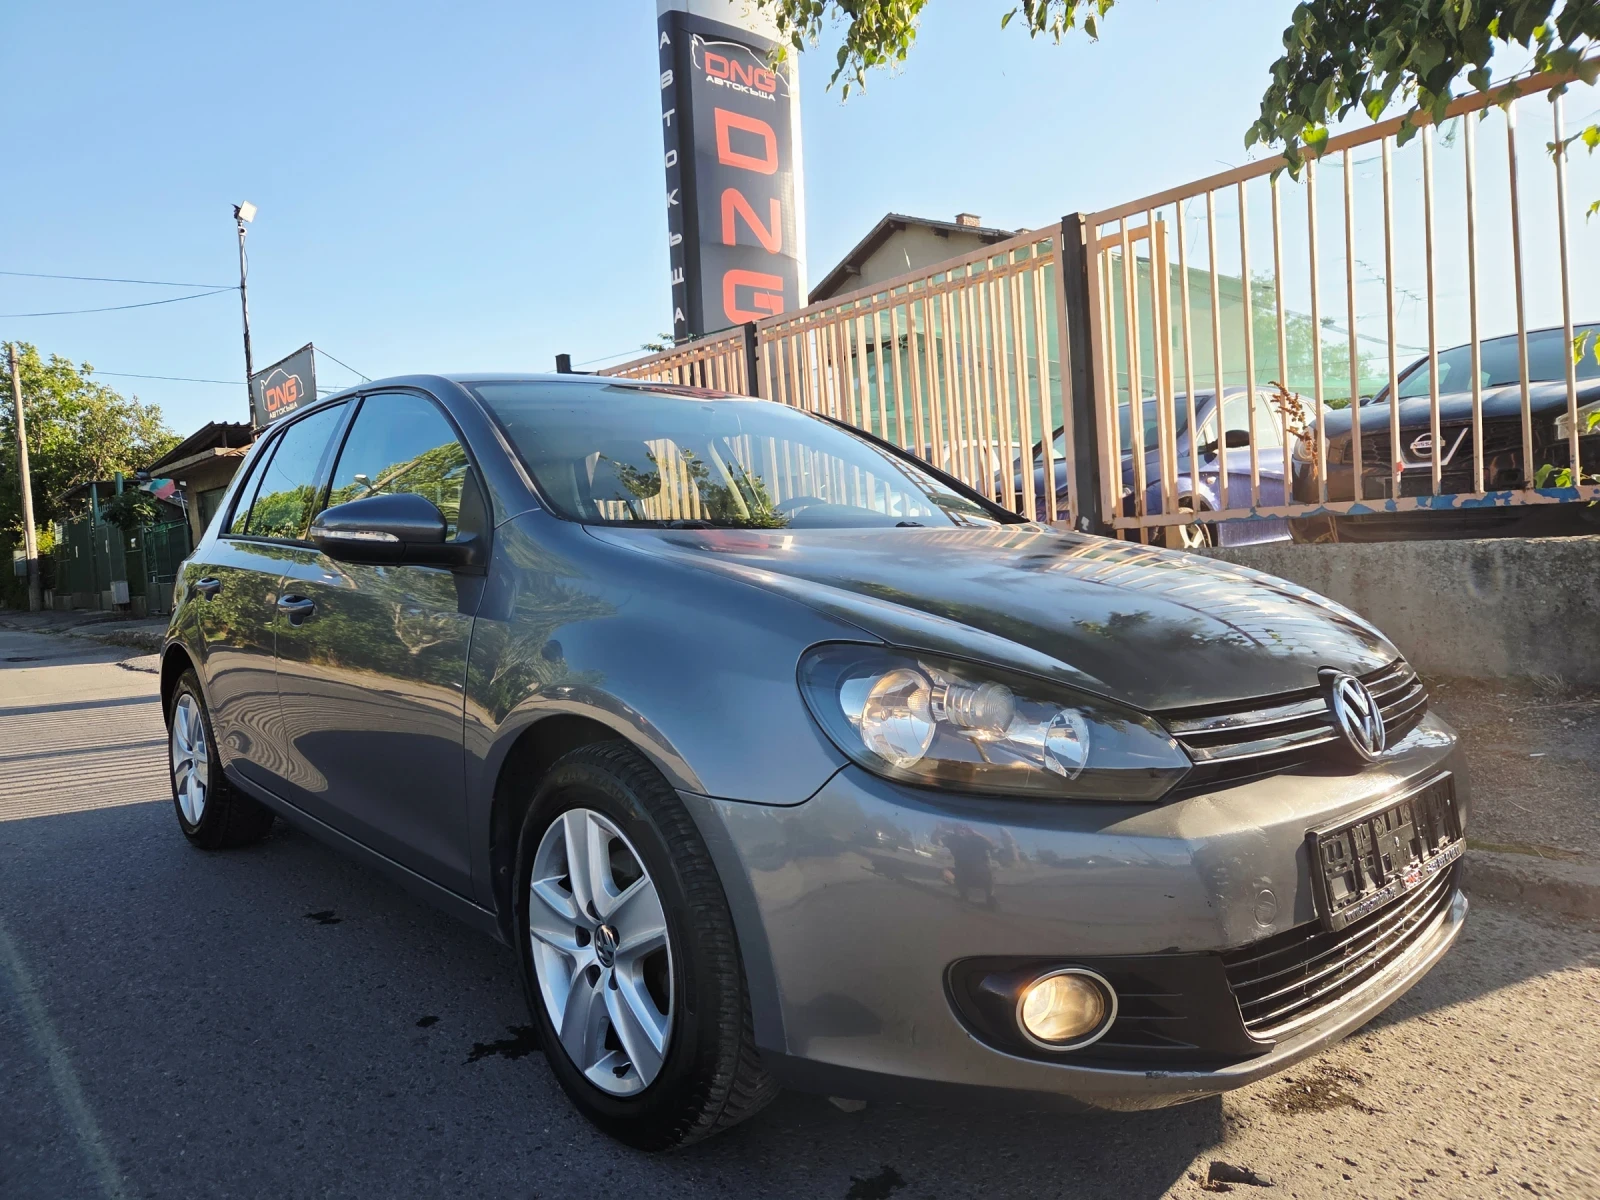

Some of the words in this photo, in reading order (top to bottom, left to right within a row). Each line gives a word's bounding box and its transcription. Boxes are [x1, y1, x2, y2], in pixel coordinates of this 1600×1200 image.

[704, 51, 777, 93] DNG
[714, 107, 784, 325] DNG
[266, 377, 297, 412] DNG
